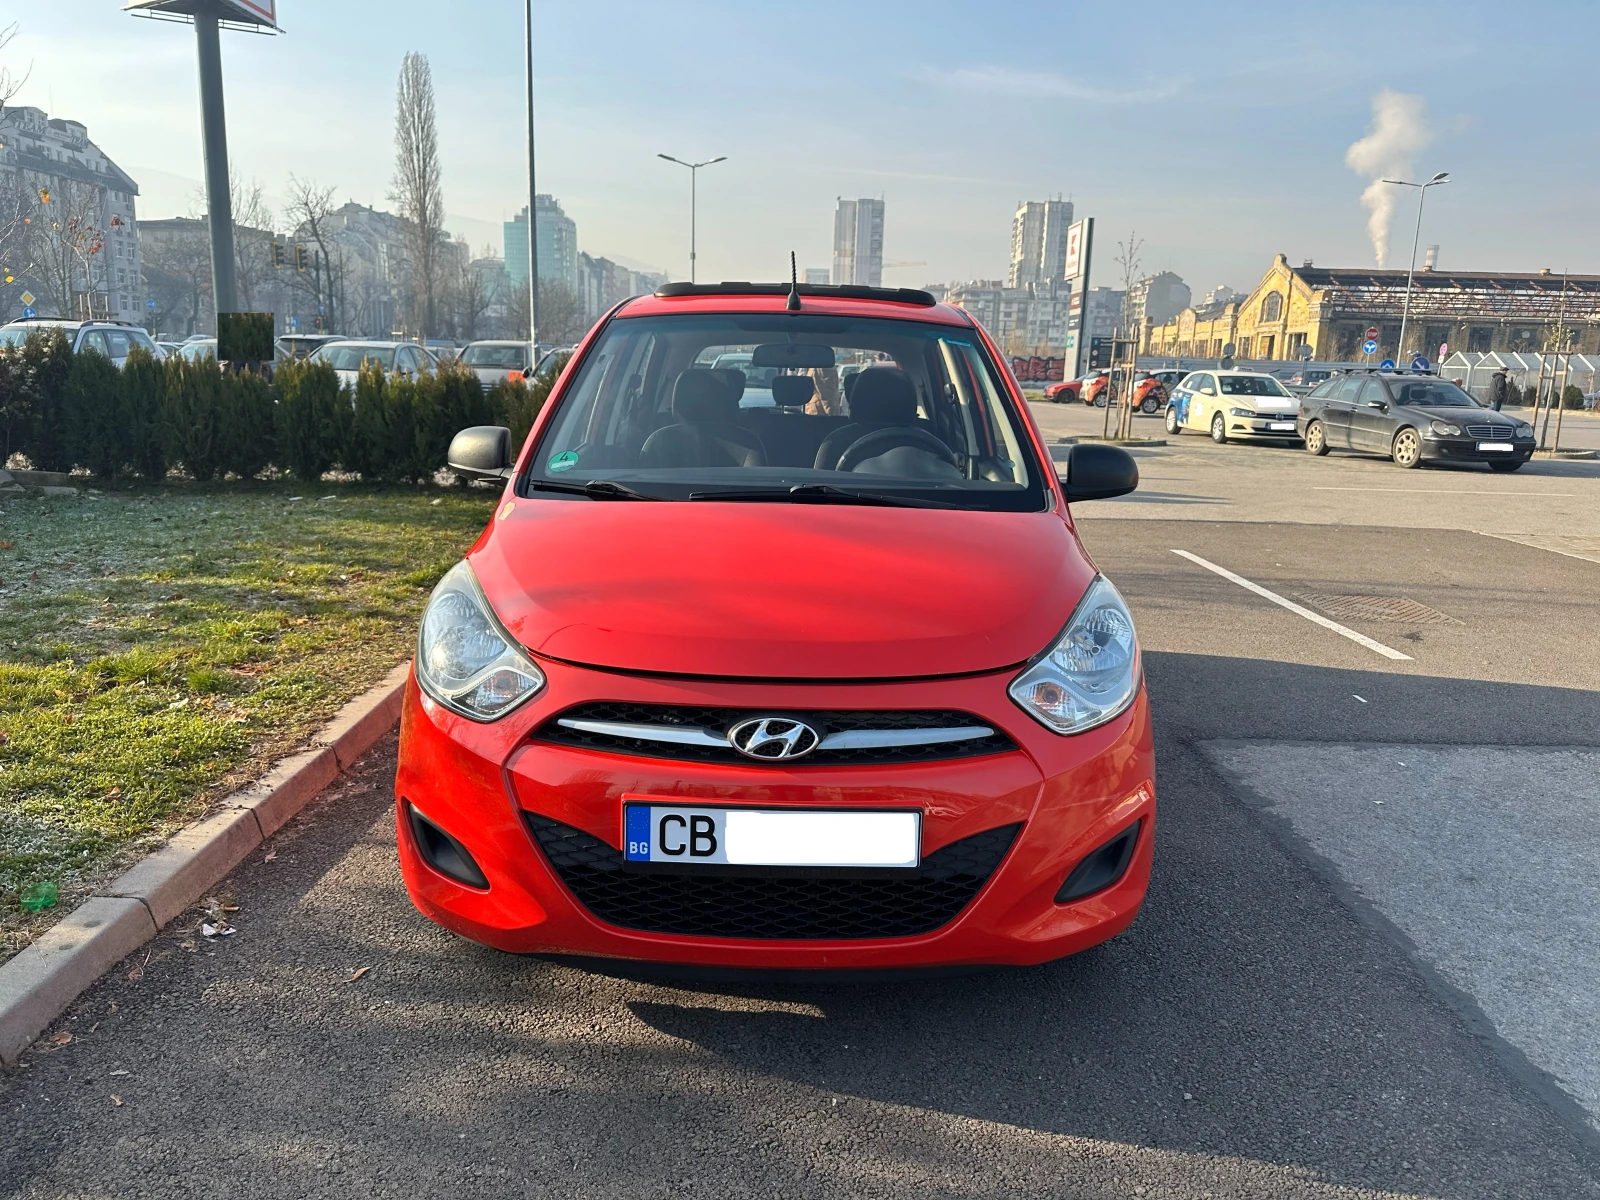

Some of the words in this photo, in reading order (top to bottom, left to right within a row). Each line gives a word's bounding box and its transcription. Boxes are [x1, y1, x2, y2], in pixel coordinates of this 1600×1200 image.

[14, 119, 47, 135] TEAM
[560, 452, 569, 461] 4
[659, 814, 717, 857] CB
[629, 841, 648, 854] BG
